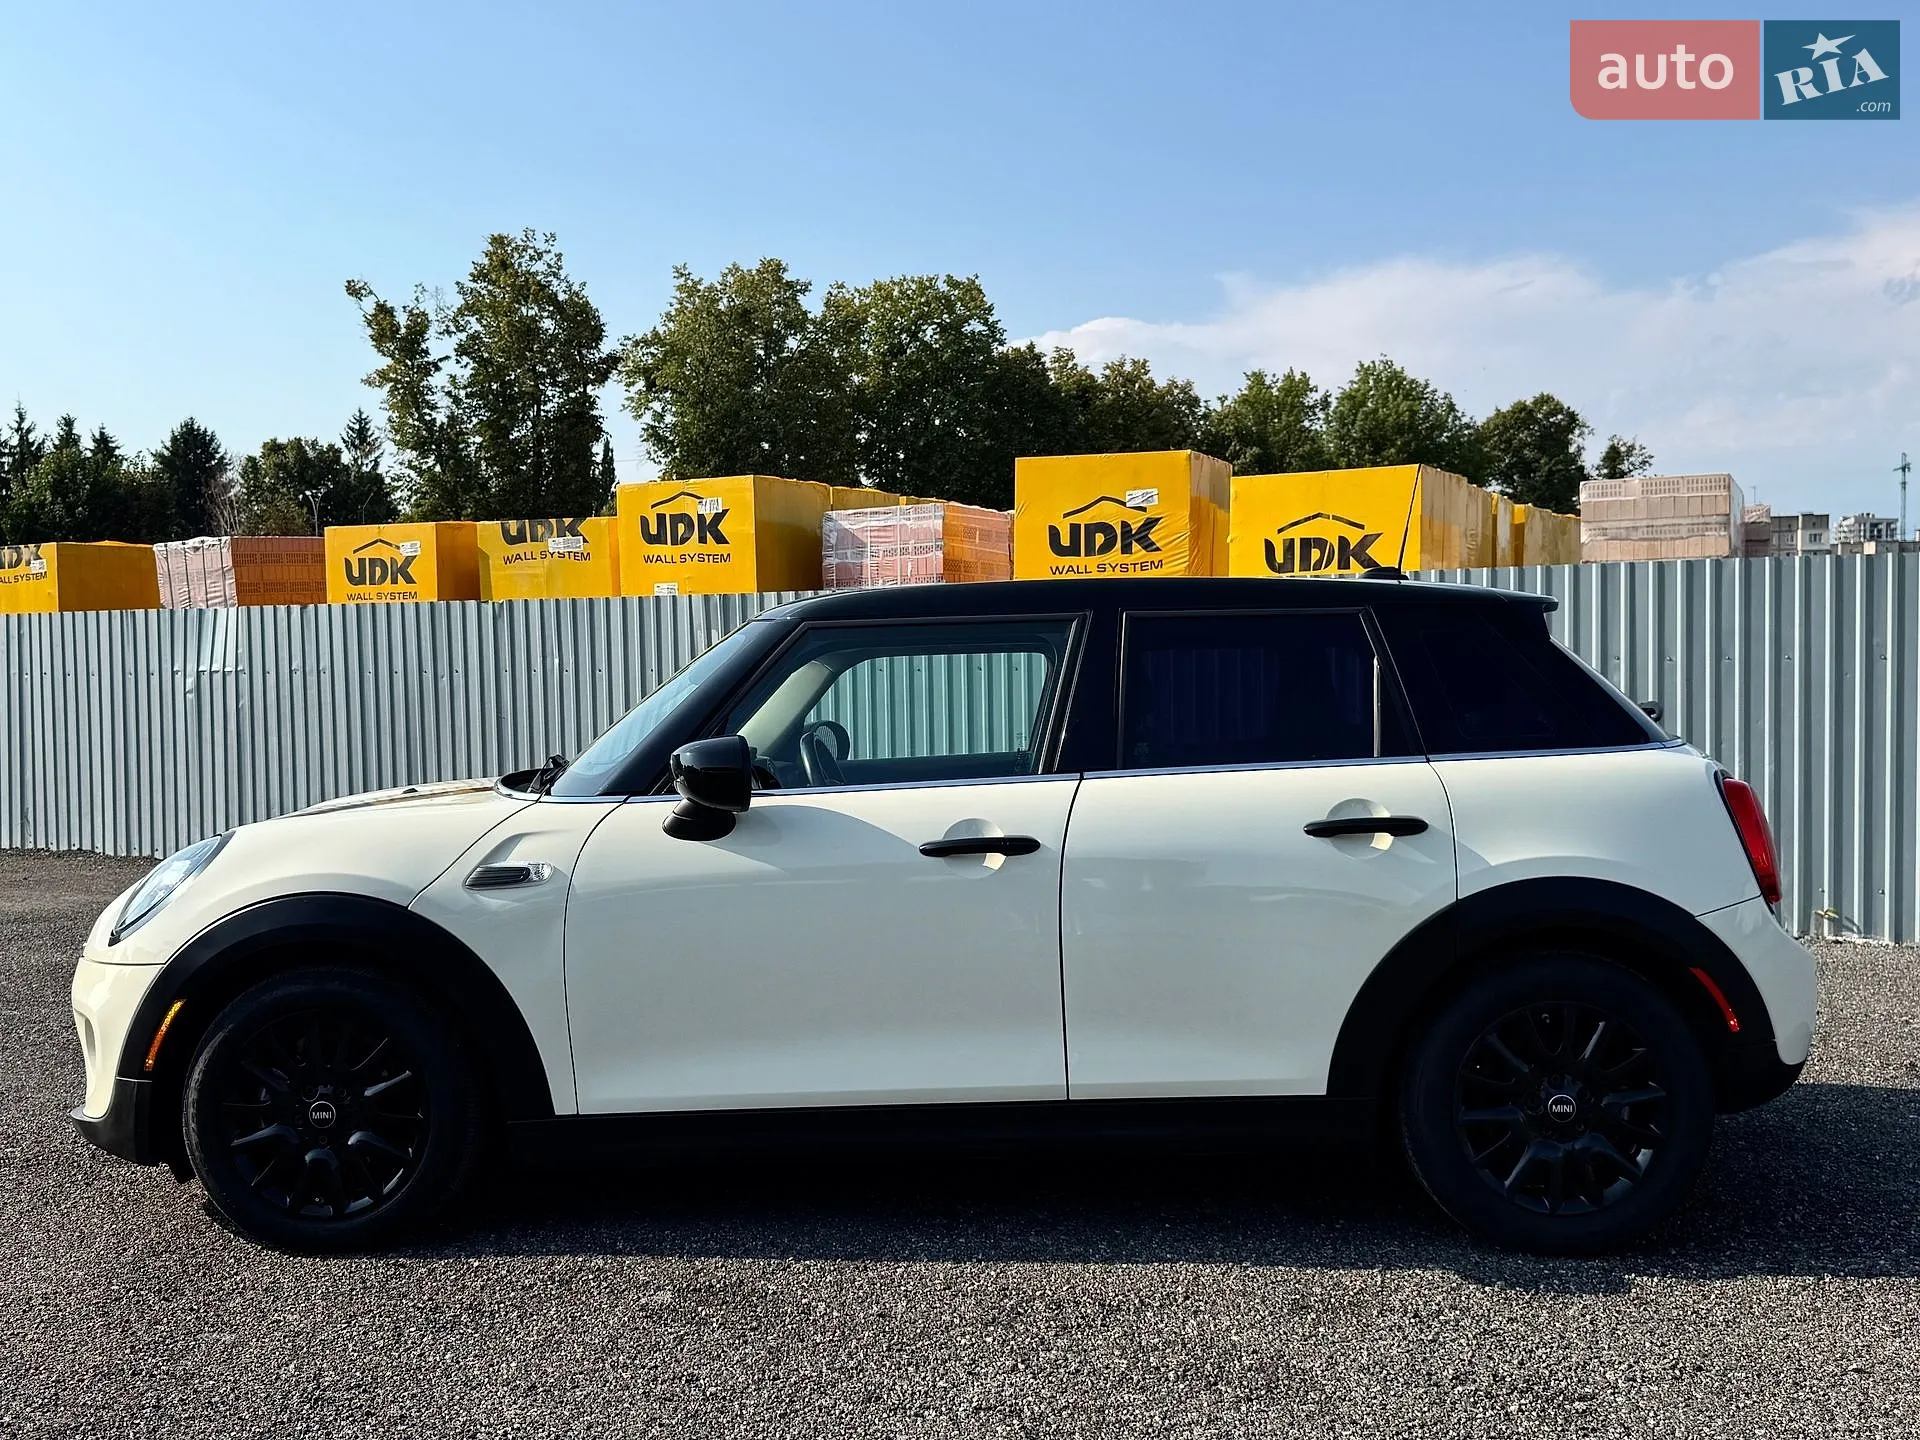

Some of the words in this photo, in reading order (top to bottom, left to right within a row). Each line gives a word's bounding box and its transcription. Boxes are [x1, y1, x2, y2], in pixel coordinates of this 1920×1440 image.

[640, 508, 731, 546] UDK
[1047, 516, 1164, 557] UDK
[503, 551, 537, 566] WALL
[540, 550, 591, 562] SYSTEM
[643, 554, 677, 564] WALL
[679, 553, 731, 563] SYSTEM
[1264, 532, 1384, 574] UDK
[344, 555, 418, 586] UDK
[1049, 564, 1093, 575] WALL
[1096, 559, 1164, 573] SYSTEM
[13, 571, 48, 583] SYSTEM
[346, 592, 373, 601] WALL
[376, 591, 418, 600] SYSTEM
[312, 1111, 332, 1119] MINI
[1552, 1104, 1573, 1113] MINI
